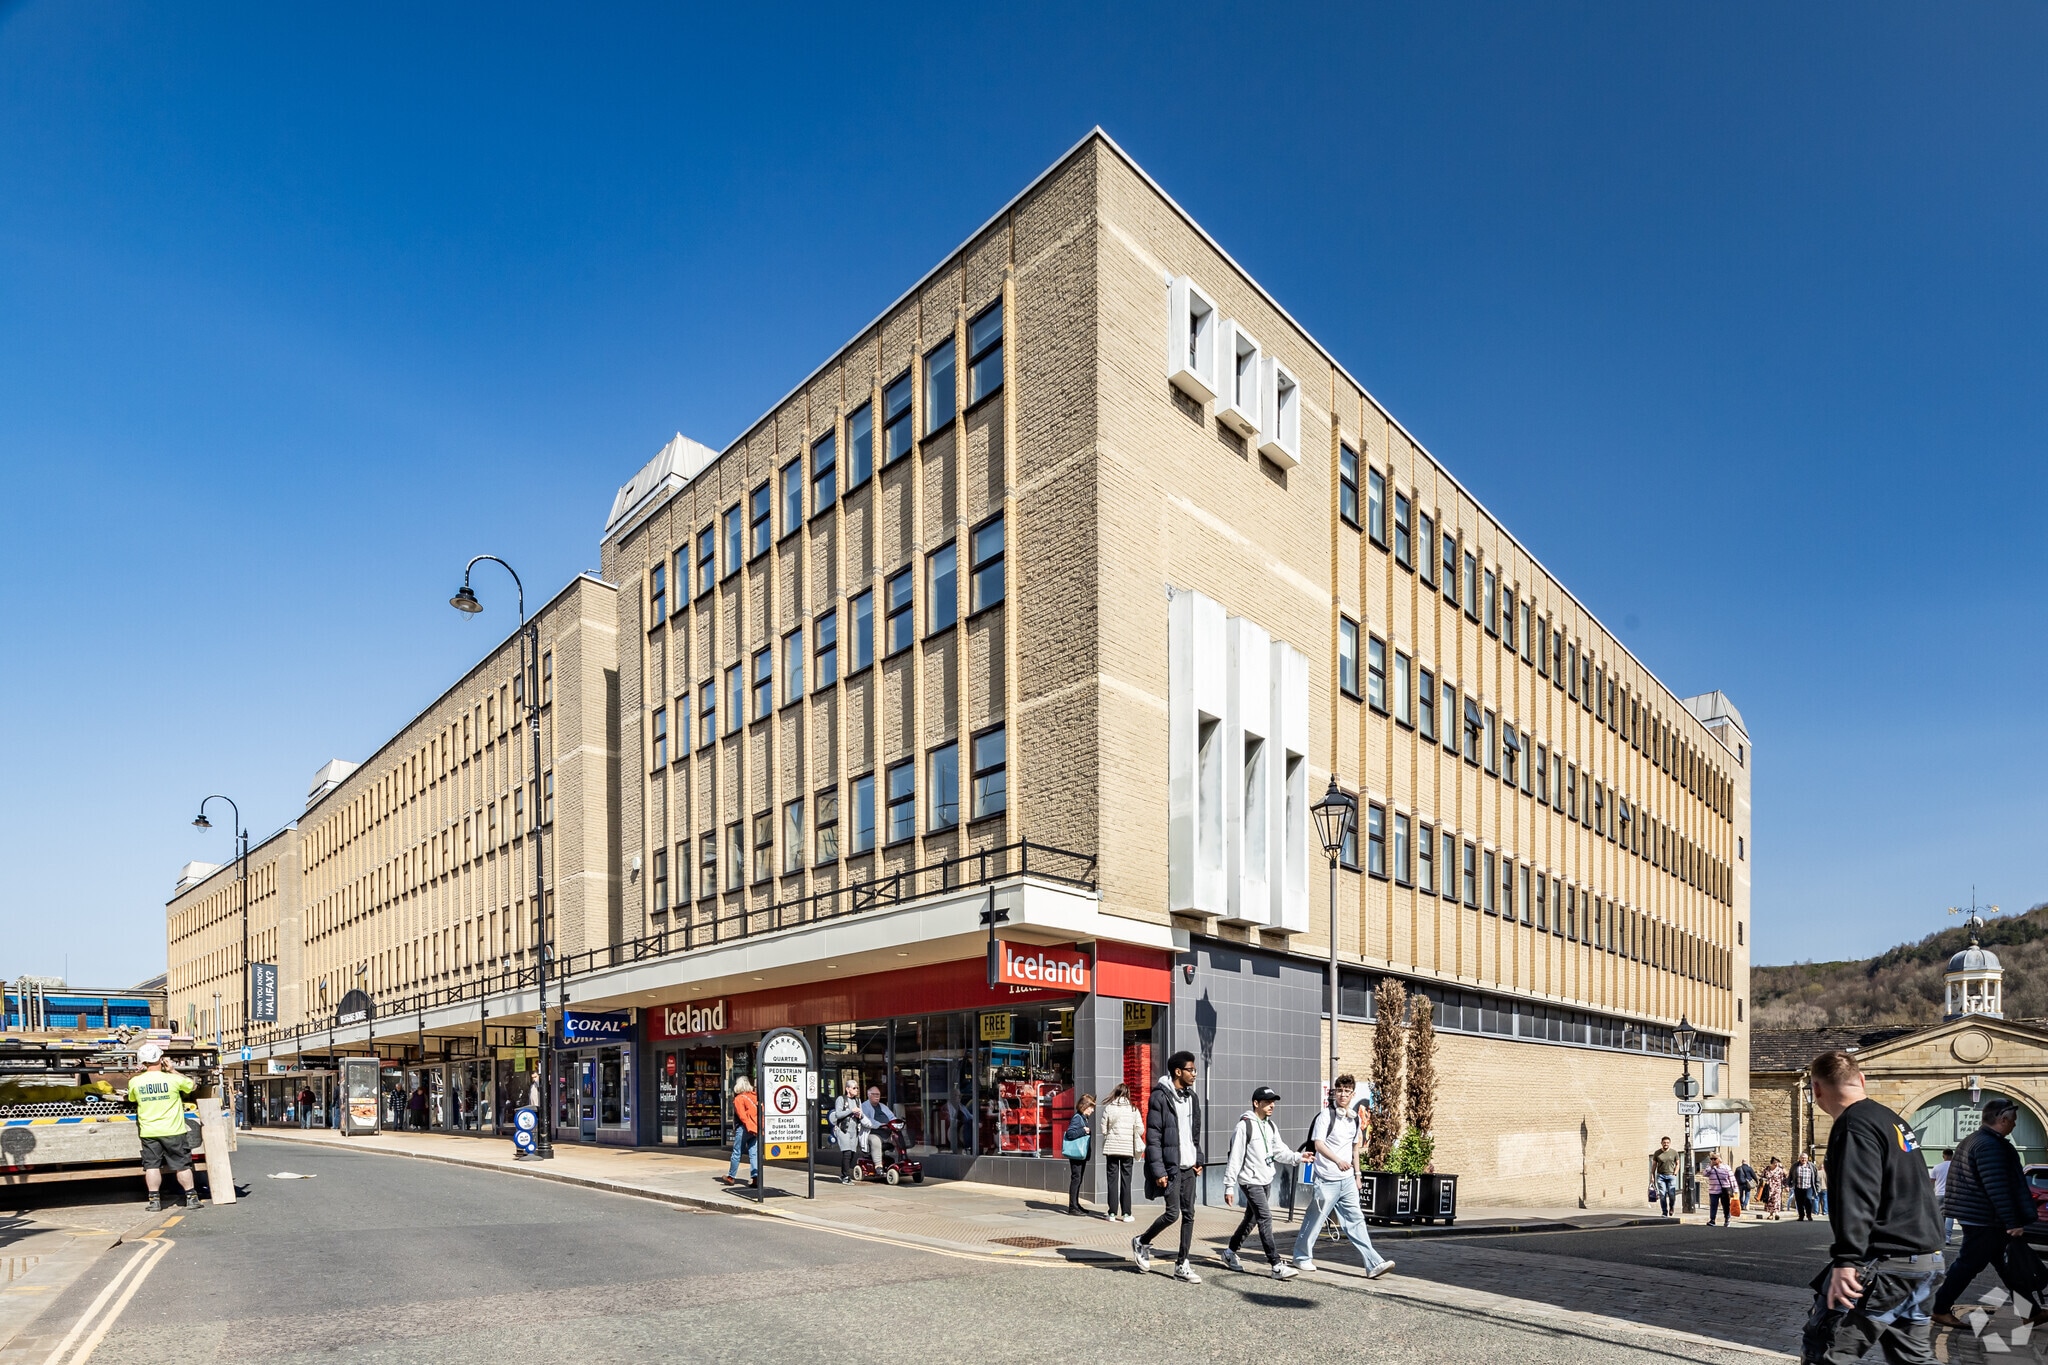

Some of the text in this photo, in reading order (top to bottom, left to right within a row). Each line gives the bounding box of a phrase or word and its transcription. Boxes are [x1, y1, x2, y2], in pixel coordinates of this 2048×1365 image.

[1007, 948, 1084, 985] Iceland
[265, 970, 274, 1016] HALIFAX?
[664, 999, 724, 1036] Iceland
[1124, 1003, 1146, 1020] REE
[566, 1019, 621, 1032] CORAL
[984, 1014, 1006, 1031] FREE
[769, 1037, 801, 1050] MARKET
[774, 1074, 798, 1083] ZONE
